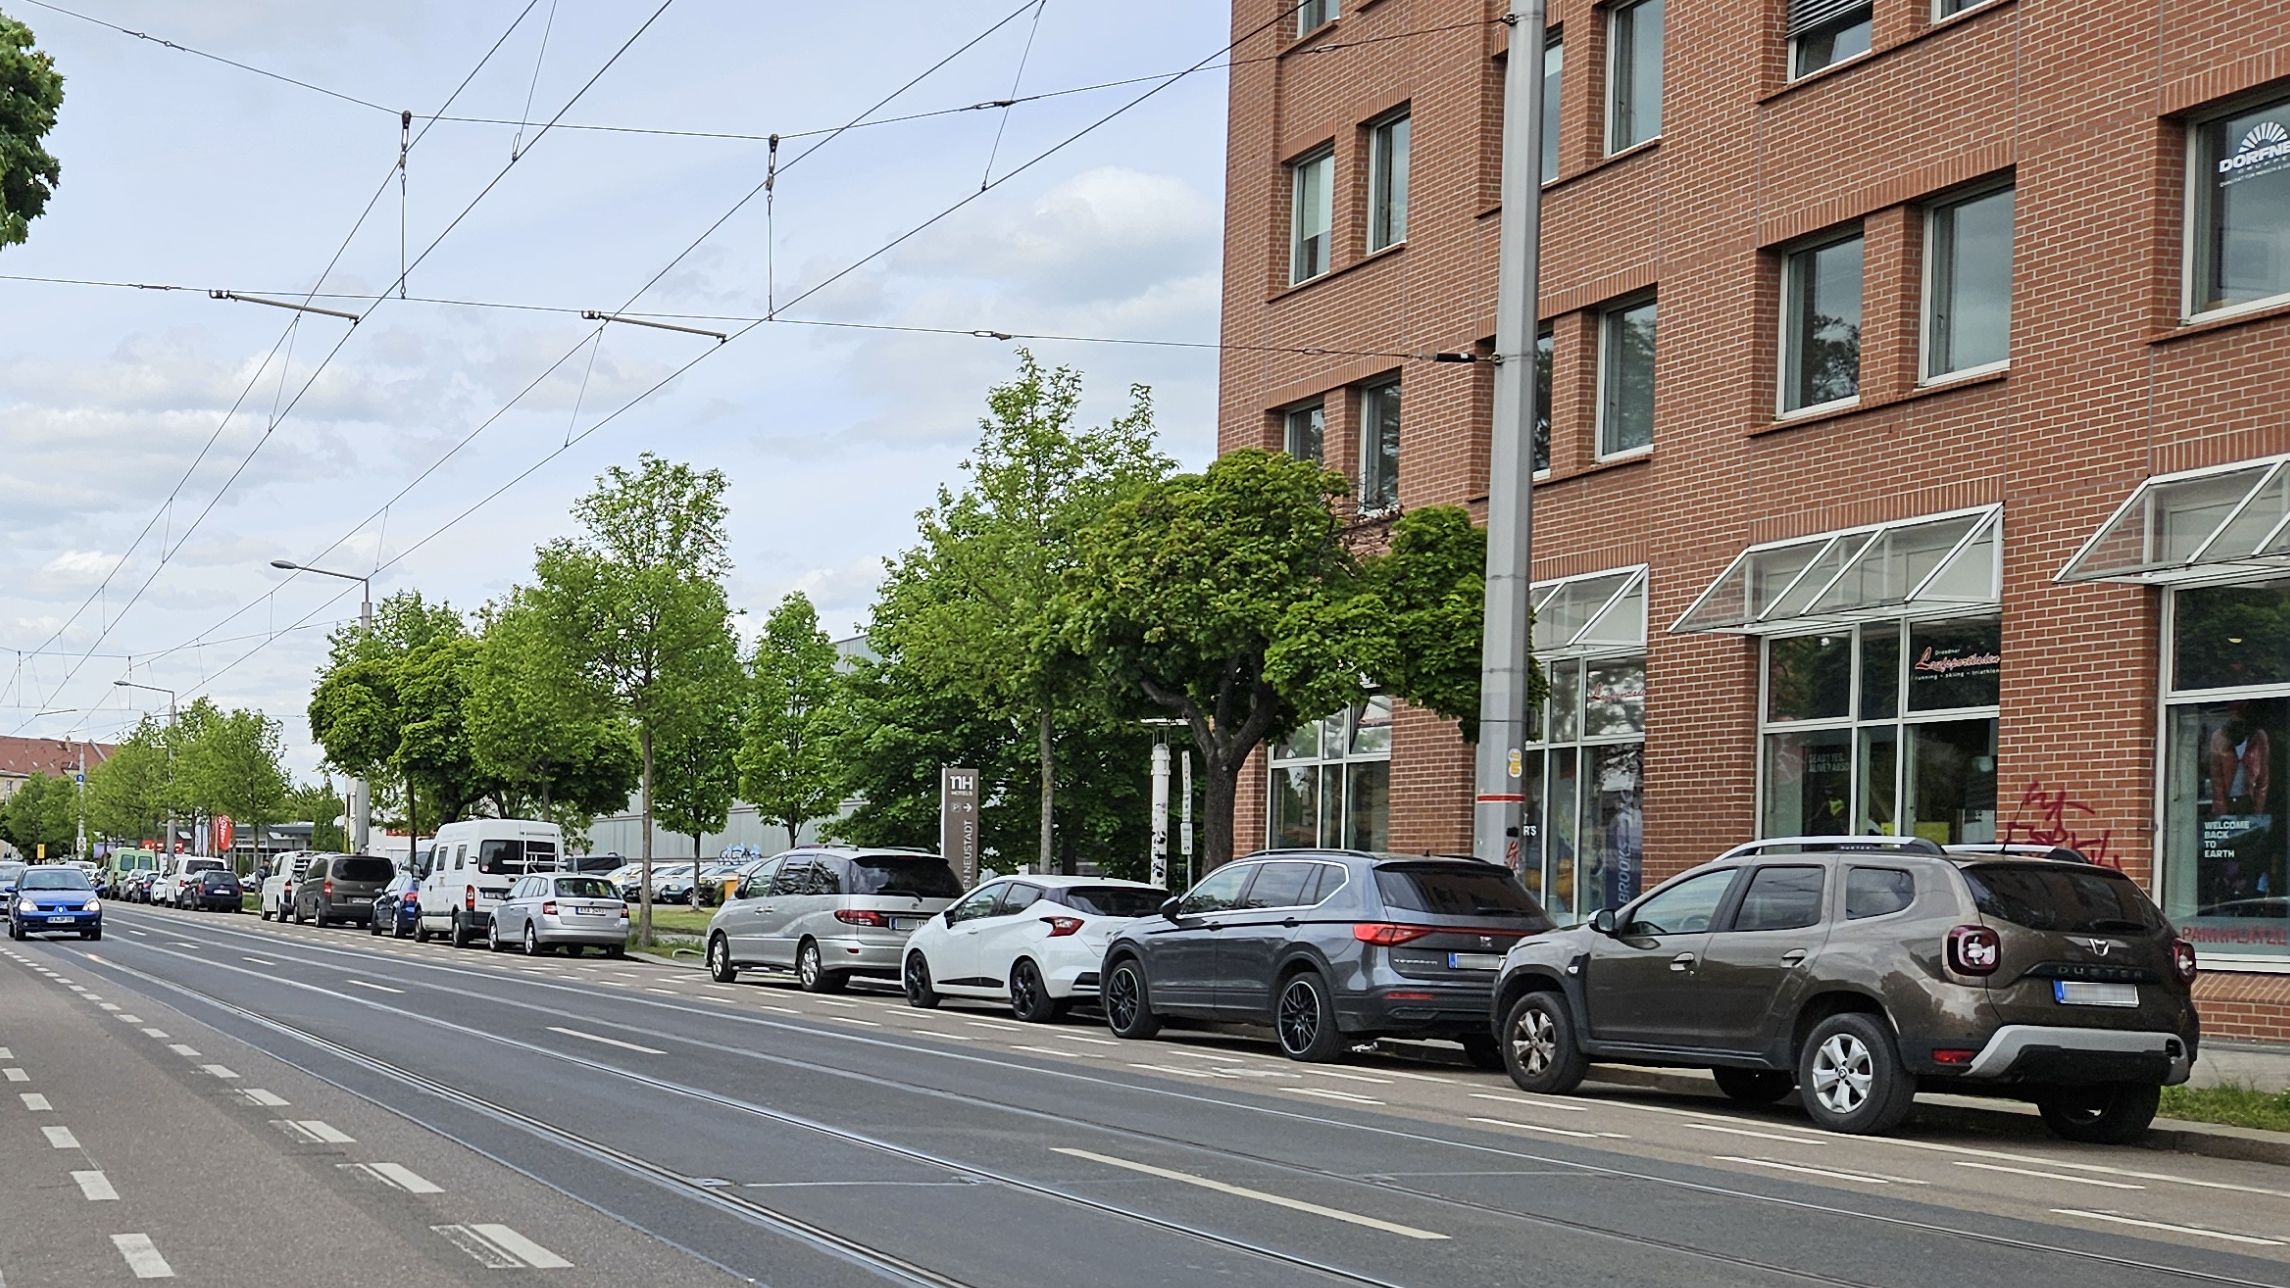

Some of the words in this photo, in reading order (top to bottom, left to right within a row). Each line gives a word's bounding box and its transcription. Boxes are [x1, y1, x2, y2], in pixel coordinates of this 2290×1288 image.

[2204, 820, 2250, 829] WELCOME
[2204, 831, 2229, 839] BACK
[963, 820, 973, 873] NEUSTADT
[2204, 840, 2217, 848] TO
[2204, 850, 2235, 858] EARTH
